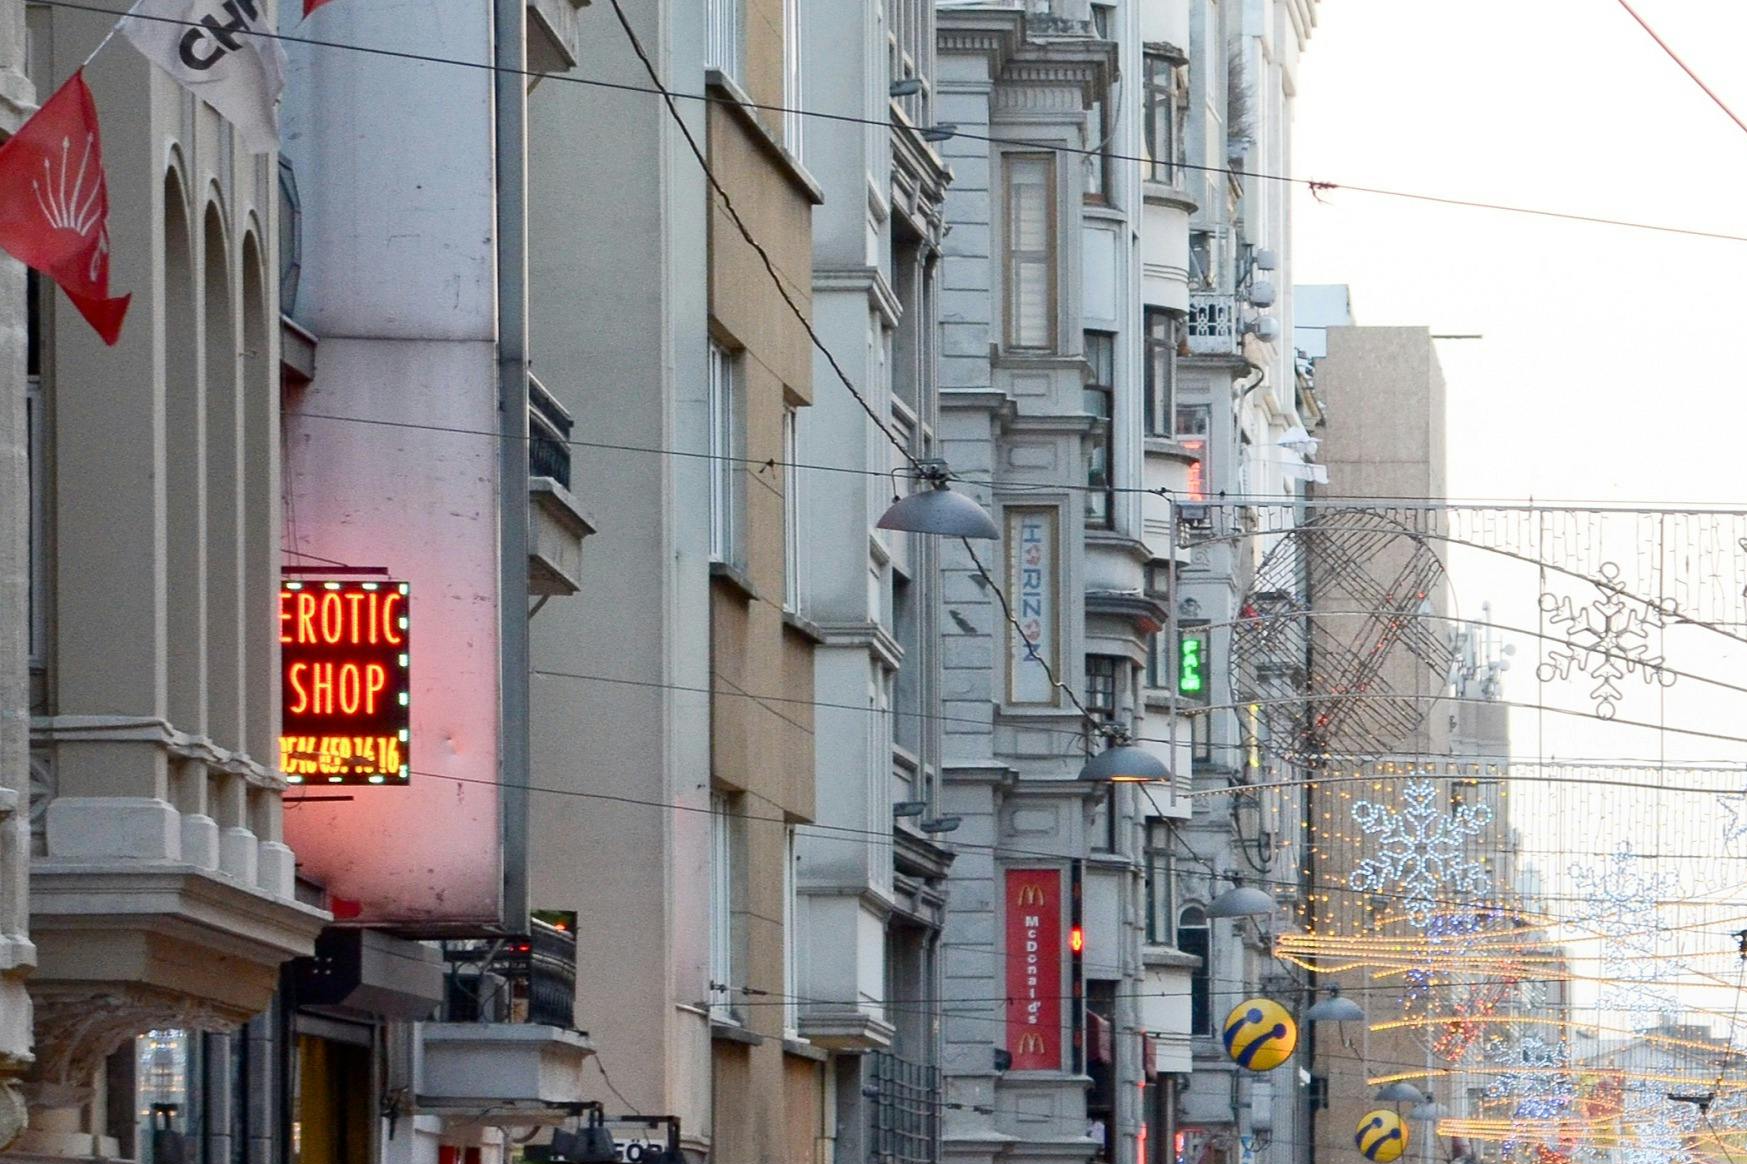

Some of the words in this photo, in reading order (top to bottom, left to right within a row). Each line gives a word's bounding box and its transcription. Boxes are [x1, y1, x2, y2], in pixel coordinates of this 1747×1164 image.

[179, 0, 258, 71] CH
[279, 592, 401, 645] EROTIC
[289, 662, 386, 715] SHOP
[1024, 915, 1042, 1025] McDonald's
